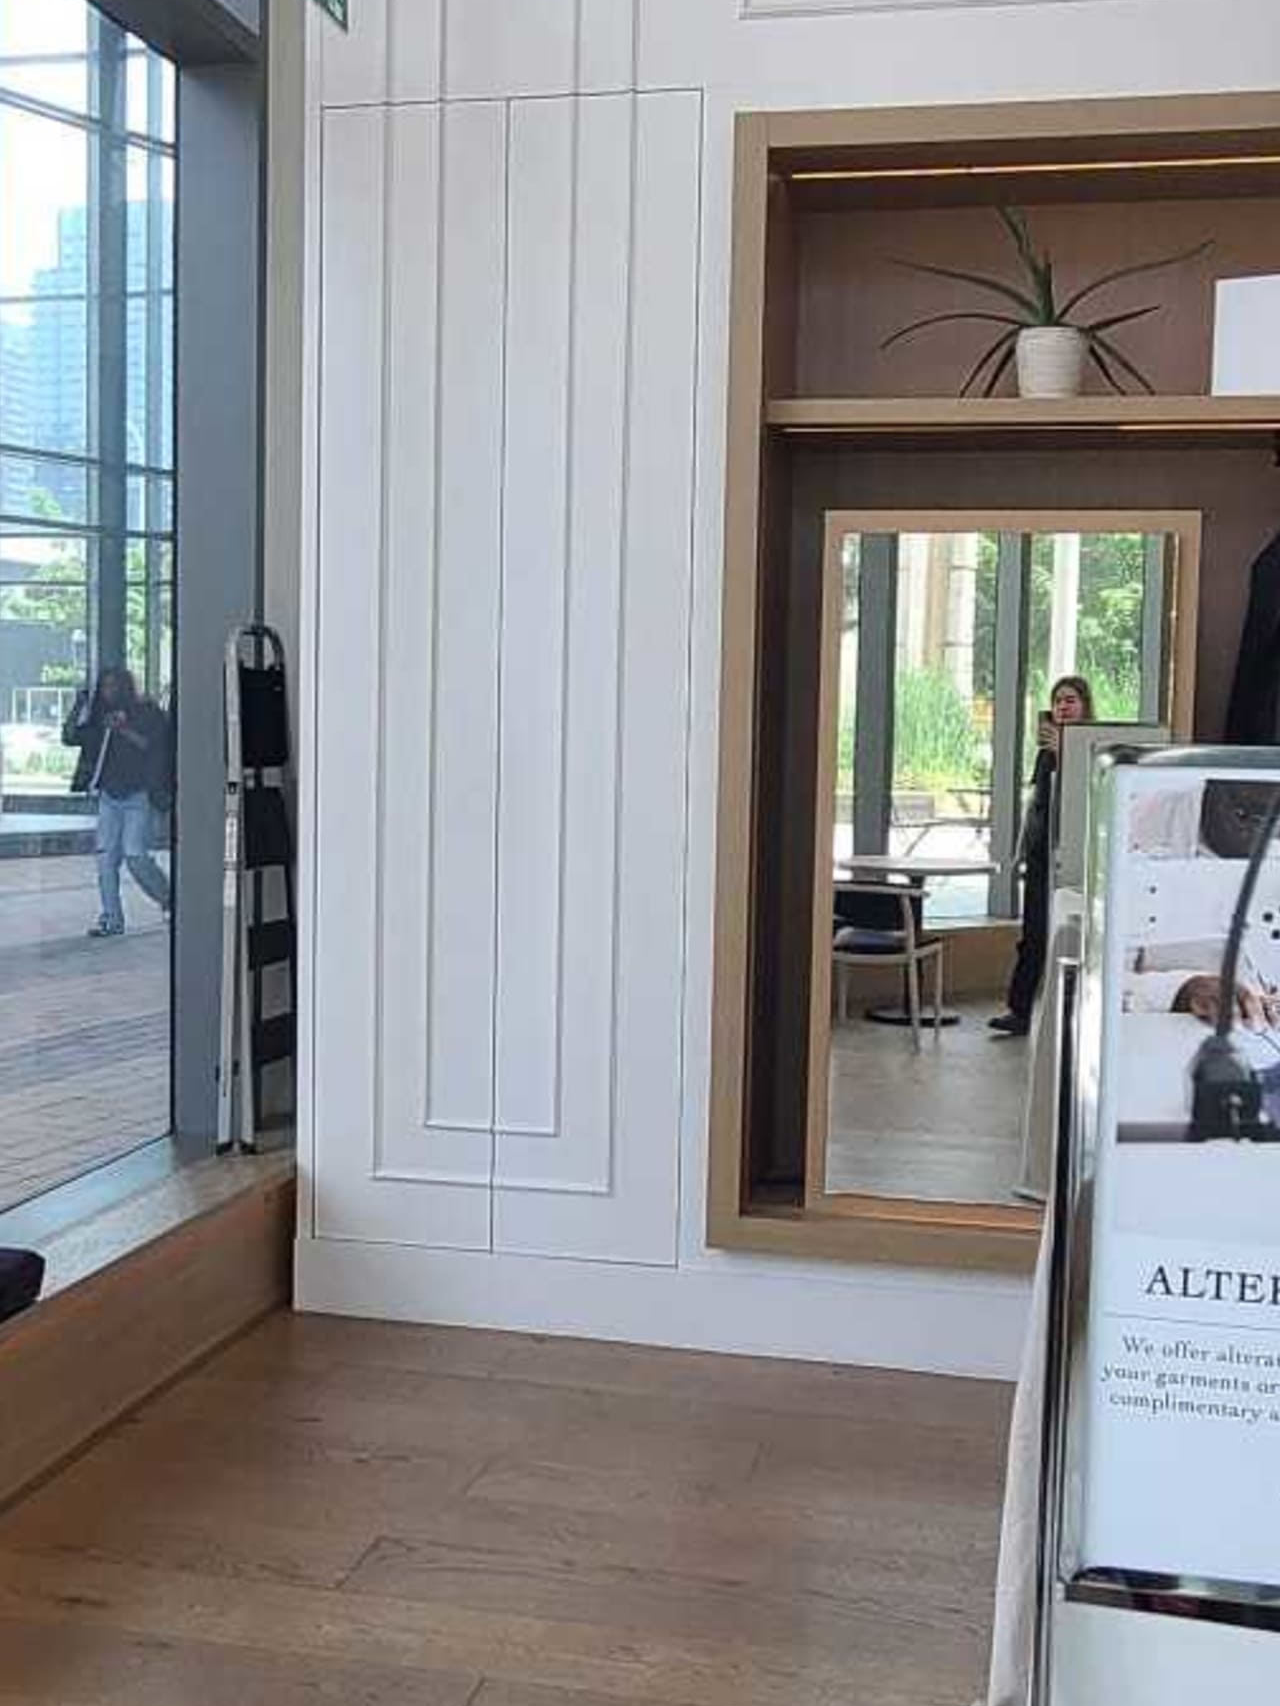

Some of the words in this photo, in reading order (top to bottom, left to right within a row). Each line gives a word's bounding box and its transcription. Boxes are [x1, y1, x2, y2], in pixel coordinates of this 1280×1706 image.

[1122, 1336, 1154, 1357] We
[1161, 1341, 1210, 1362] offer
[1100, 1362, 1151, 1383] your
[1155, 1367, 1251, 1393] garments
[1256, 1378, 1278, 1394] or
[1109, 1391, 1264, 1424] complimentary
